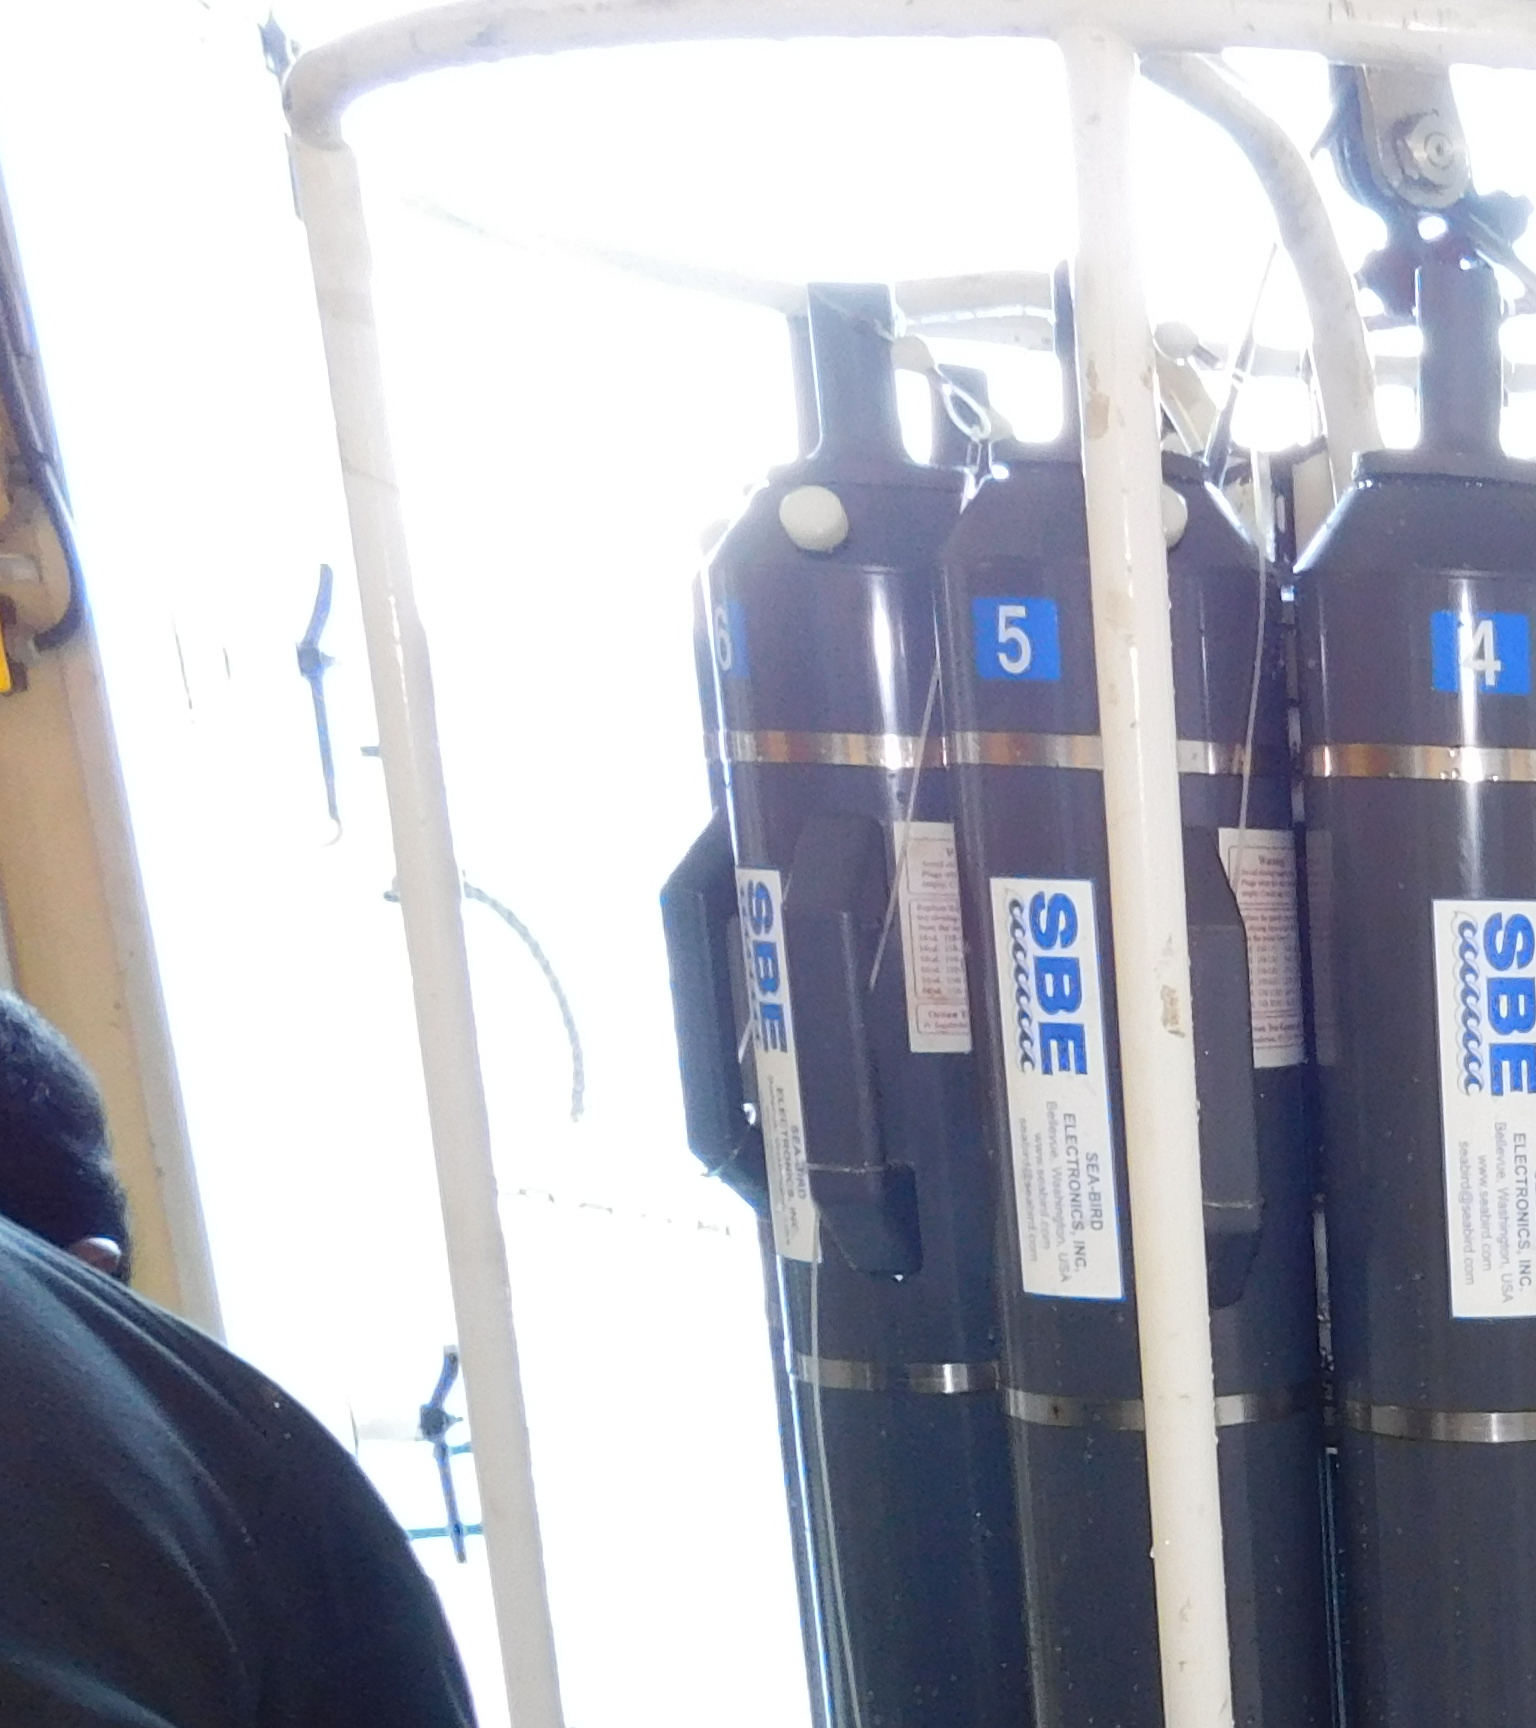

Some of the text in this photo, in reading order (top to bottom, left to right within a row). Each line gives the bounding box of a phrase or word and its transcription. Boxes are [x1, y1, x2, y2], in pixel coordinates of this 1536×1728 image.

[714, 605, 733, 672] 6
[997, 603, 1033, 676] 5
[1461, 619, 1502, 686] 4
[747, 879, 789, 1054] SBE
[1029, 890, 1088, 1076] SBE
[1063, 1112, 1086, 1236] ELECTRONICS,
[1086, 1151, 1104, 1231] SEA-BIRD
[1458, 1139, 1475, 1286] seabird@seabird.com
[1477, 1154, 1492, 1272] www.seabird.com
[1513, 1132, 1532, 1255] ELECTRONICS,
[1057, 1252, 1073, 1284] USA
[1500, 1272, 1515, 1304] USA
